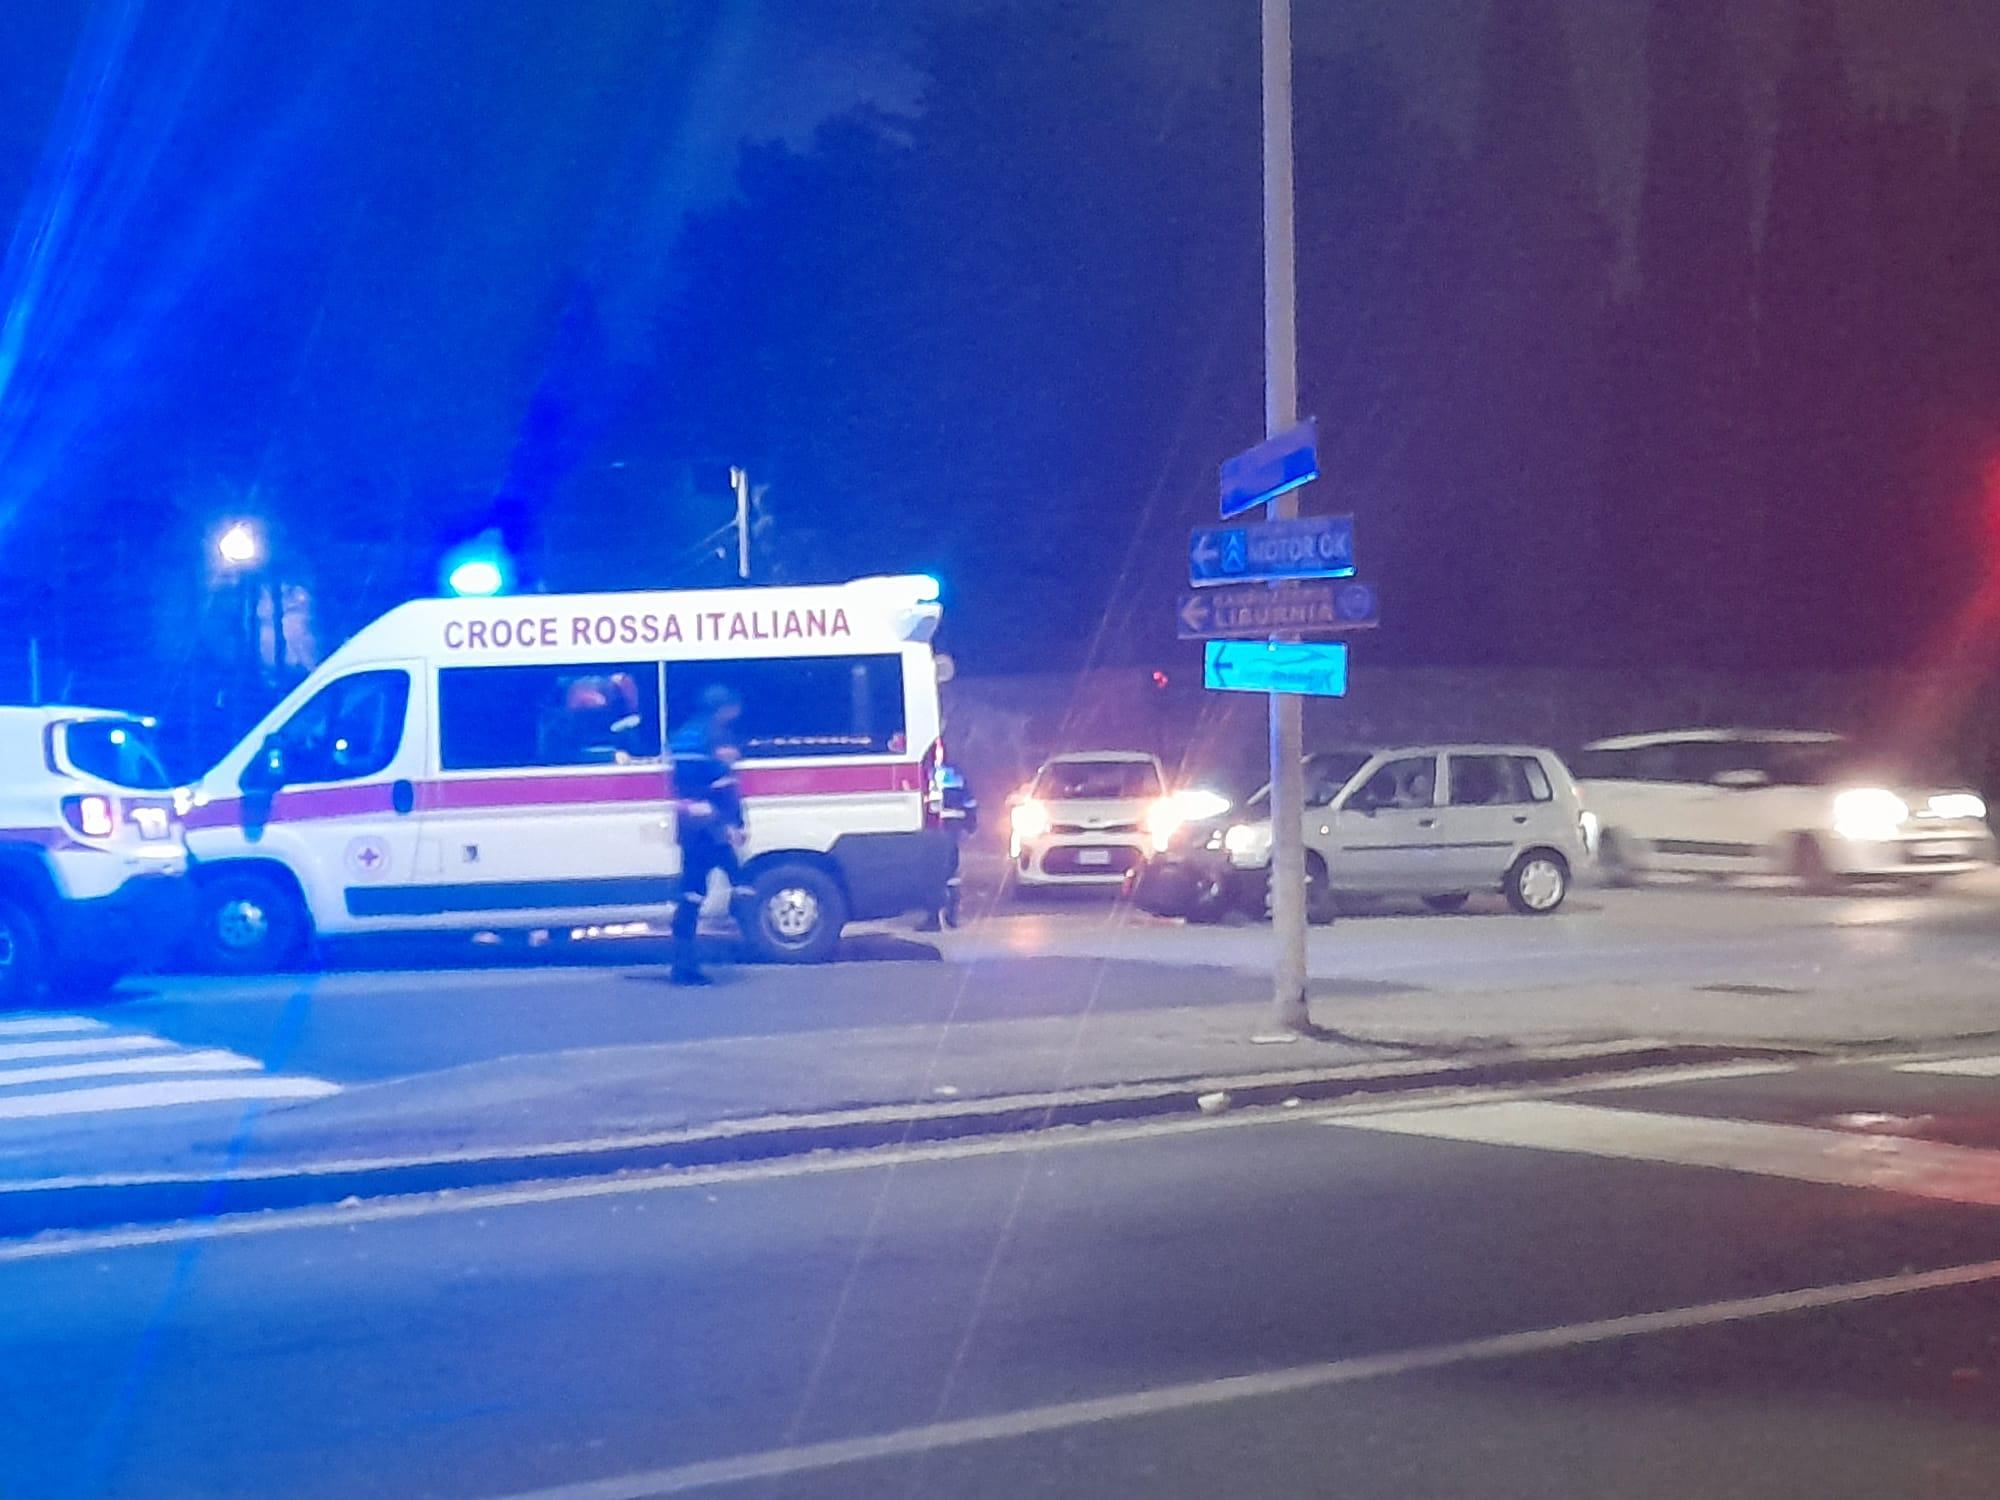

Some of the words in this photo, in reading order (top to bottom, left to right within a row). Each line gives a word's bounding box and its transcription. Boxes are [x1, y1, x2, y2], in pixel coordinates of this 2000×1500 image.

[444, 617, 558, 649] CROCE
[571, 614, 683, 645] ROSSA
[696, 608, 851, 641] ITALIANA
